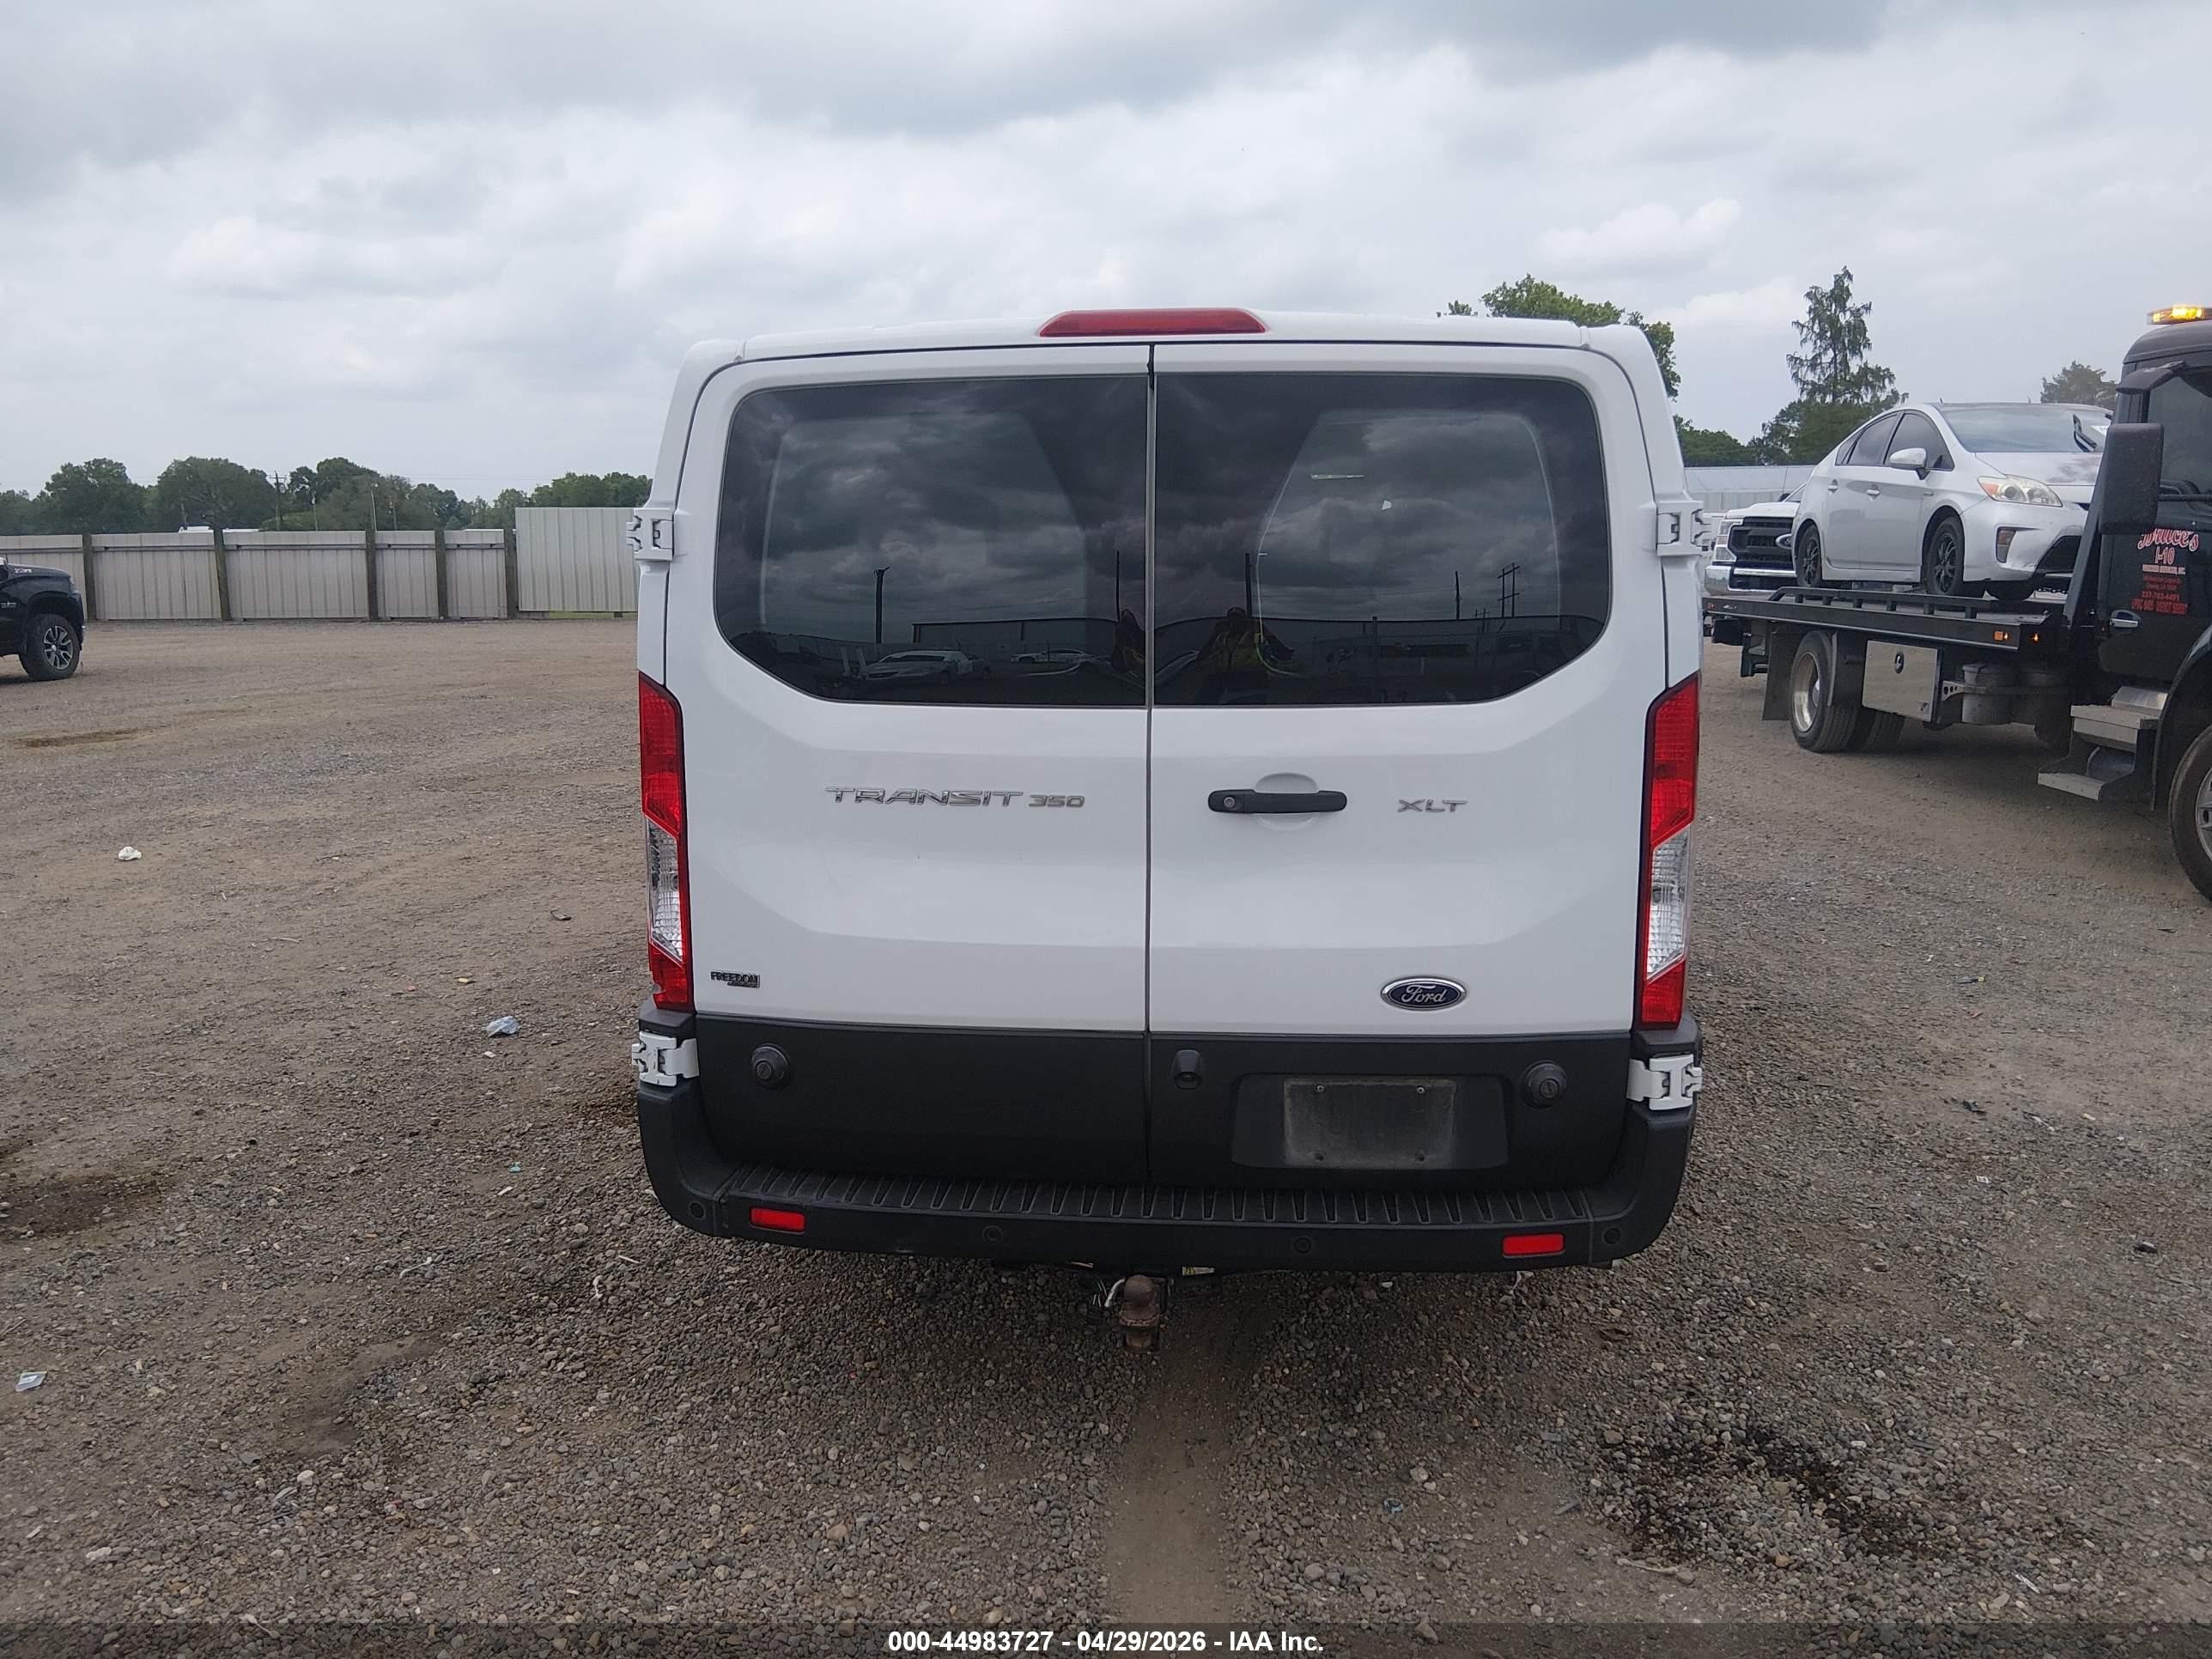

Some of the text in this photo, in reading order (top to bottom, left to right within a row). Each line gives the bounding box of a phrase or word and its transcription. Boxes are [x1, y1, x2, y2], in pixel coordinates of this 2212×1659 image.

[825, 787, 1085, 808] TRANSIT 350
[1397, 799, 1468, 813] XLT
[1401, 984, 1449, 1003] Ford
